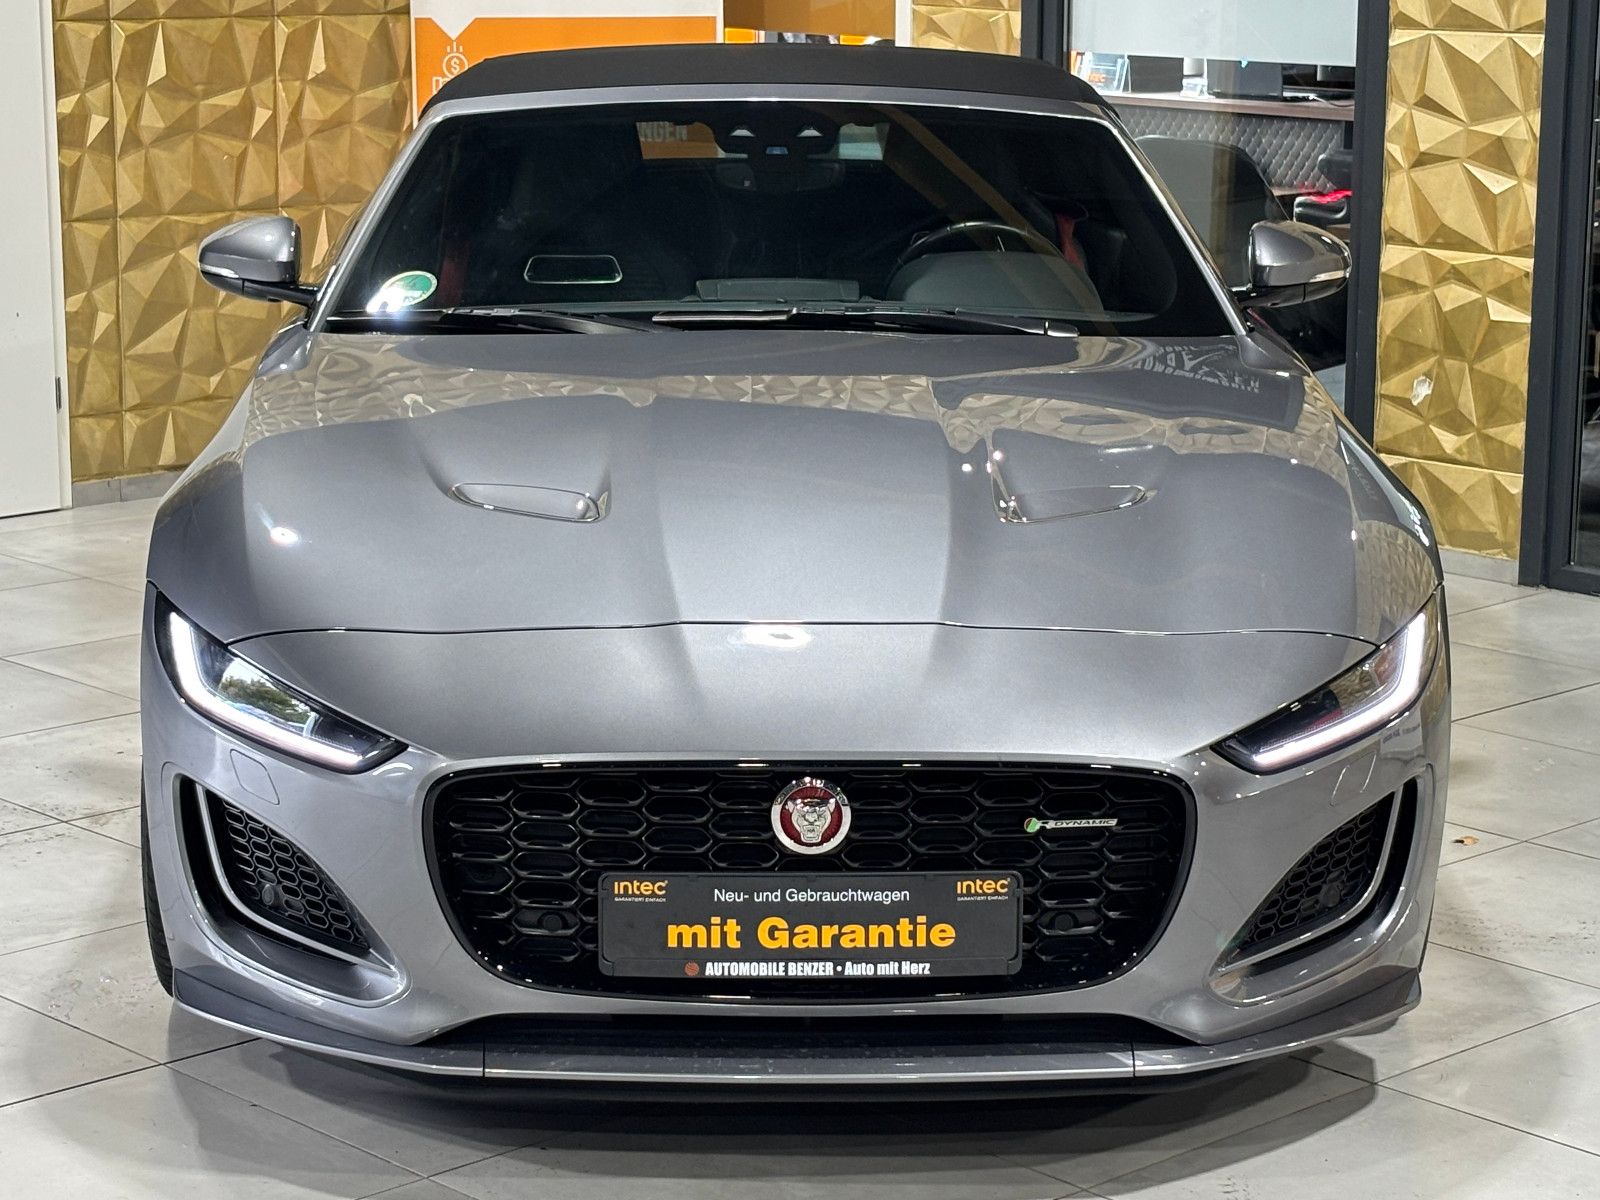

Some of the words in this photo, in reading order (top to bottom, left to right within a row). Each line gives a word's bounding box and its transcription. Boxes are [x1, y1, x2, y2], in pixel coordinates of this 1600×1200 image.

[1054, 818, 1116, 827] DYNAMIC
[614, 880, 667, 895] intec
[956, 879, 1009, 894] intec
[714, 889, 749, 902] Neu-
[754, 889, 780, 902] und
[786, 889, 910, 905] Gebrauchtwagen
[667, 916, 741, 948] mit
[757, 915, 956, 949] Garantie
[705, 962, 785, 976] AUTOMOBILE
[788, 962, 834, 976] BENZER
[844, 961, 875, 976] Auto
[877, 961, 900, 975] mit
[901, 961, 931, 975] Herz
